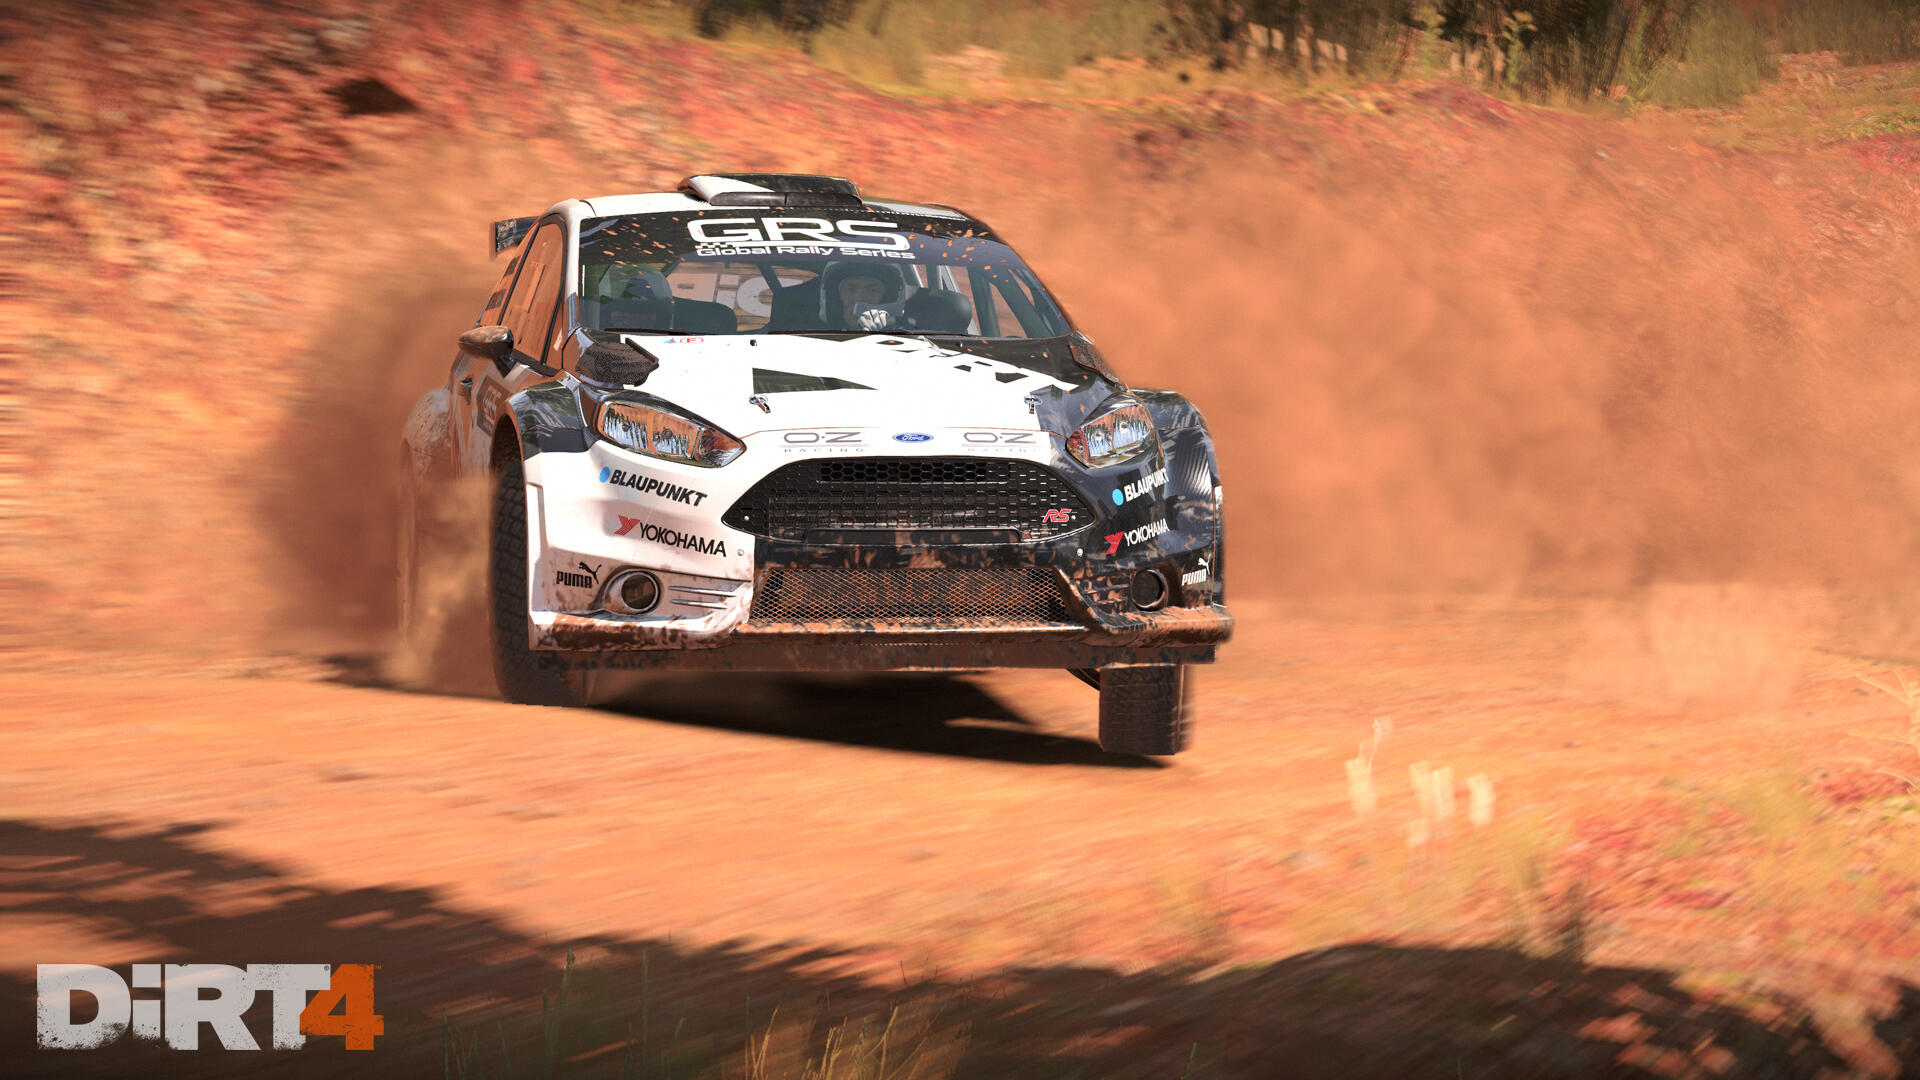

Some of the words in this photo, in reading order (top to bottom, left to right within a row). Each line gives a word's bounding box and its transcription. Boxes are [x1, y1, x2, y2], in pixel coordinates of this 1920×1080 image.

[687, 217, 910, 250] GRS
[697, 246, 771, 257] Global
[777, 246, 835, 256] Rally
[841, 247, 916, 259] Series
[610, 469, 707, 507] BLAUPUNKT
[1124, 468, 1169, 502] BLAUPUNKT
[1042, 509, 1072, 523] RS
[1124, 518, 1170, 546] YOKOHAMA
[640, 522, 727, 557] YOKOHAMA
